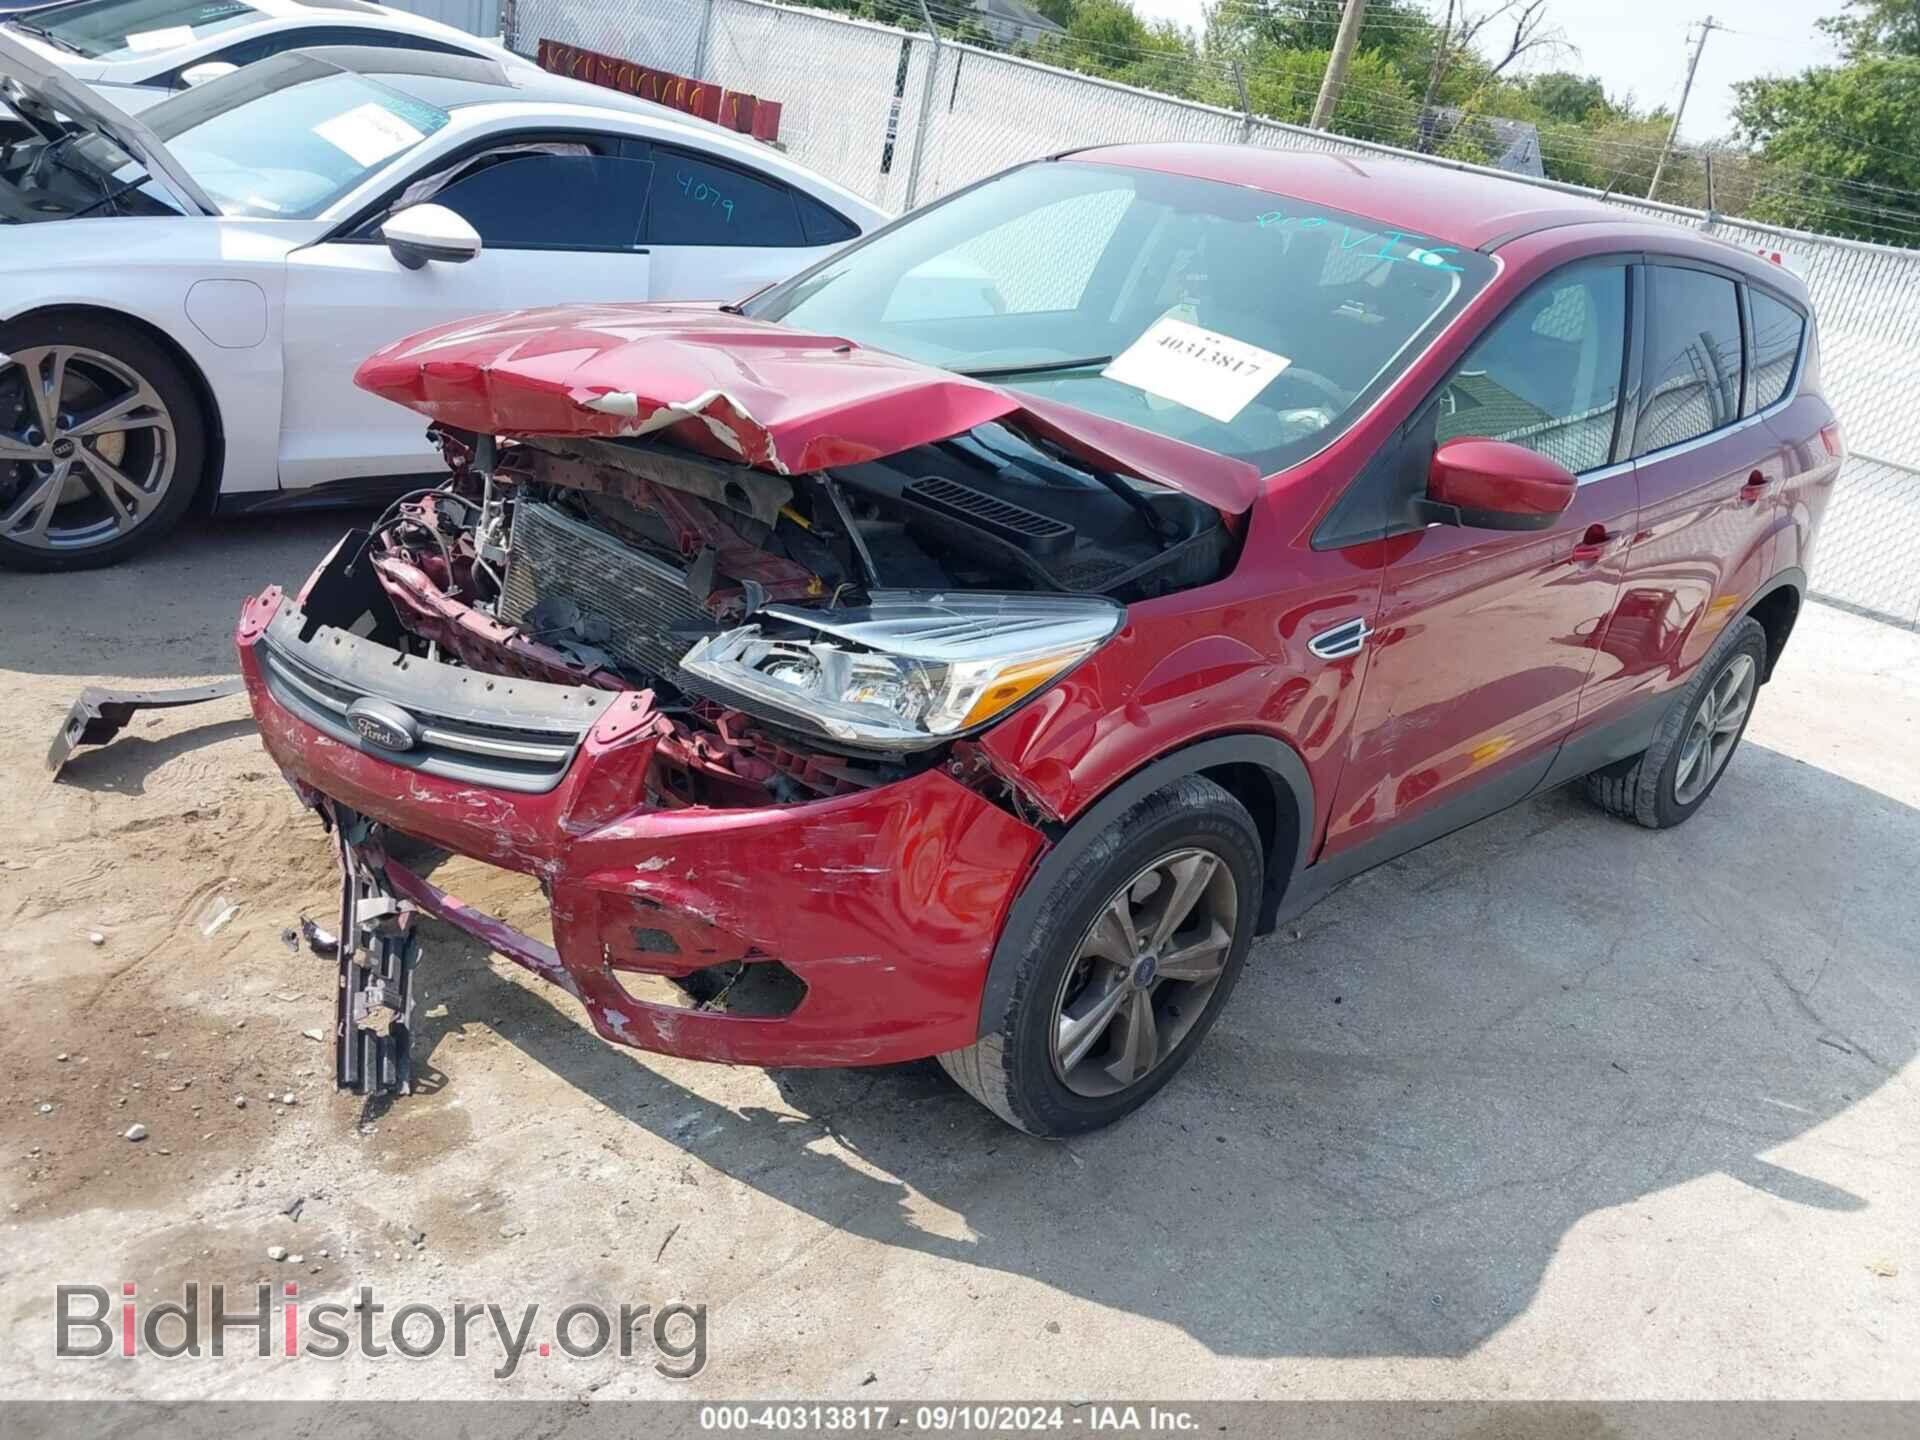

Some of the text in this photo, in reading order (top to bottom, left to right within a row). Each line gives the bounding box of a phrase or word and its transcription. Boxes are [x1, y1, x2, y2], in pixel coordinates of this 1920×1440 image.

[673, 169, 734, 224] 4079
[1157, 335, 1262, 377] 40313817
[357, 718, 394, 745] Ford
